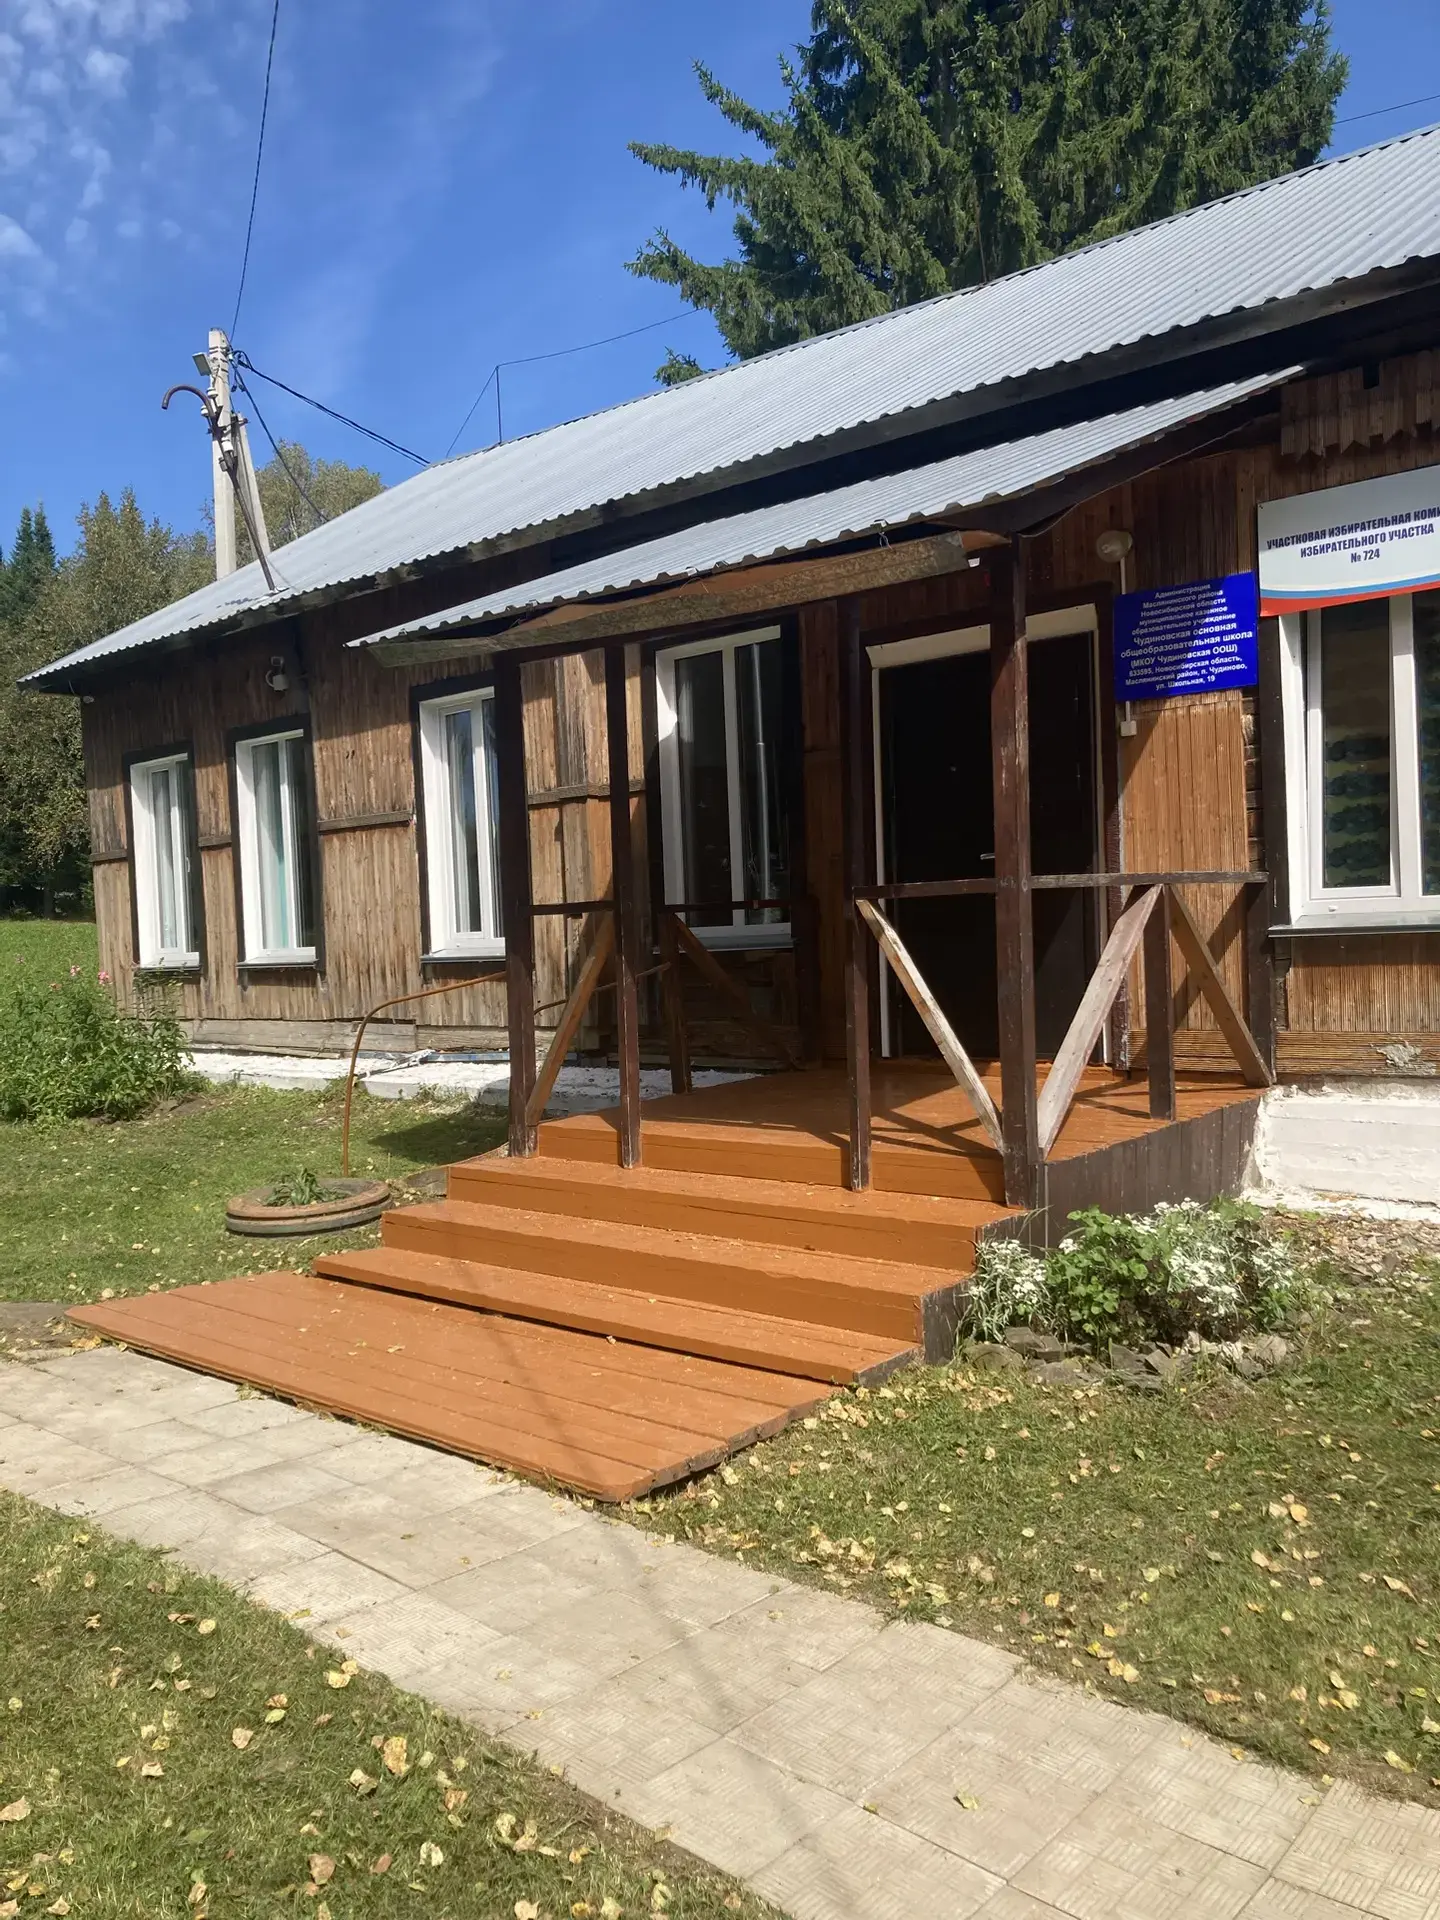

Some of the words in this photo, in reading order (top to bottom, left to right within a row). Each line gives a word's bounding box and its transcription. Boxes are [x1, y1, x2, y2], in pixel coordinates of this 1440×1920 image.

[1267, 530, 1326, 549] УЧАСТКОВАЯ
[1329, 512, 1411, 538] ИЗБИРАТЕЛЬНАЯ
[1301, 533, 1386, 558] ИЗБИРАТЕЛЬНОГО
[1389, 524, 1434, 542] УЧАСТКА
[1351, 553, 1361, 563] №
[1363, 549, 1380, 560] 724
[1143, 595, 1196, 608] Маслянинского
[1198, 590, 1223, 600] района
[1155, 584, 1211, 599] Администрация
[1141, 603, 1195, 617] Новосибирской
[1197, 598, 1226, 607] области
[1132, 621, 1191, 635] образовательное
[1193, 613, 1236, 626] учреждение
[1140, 612, 1194, 626] муниципальное
[1121, 636, 1220, 658] общеобразовательная
[1223, 631, 1252, 641] школа
[1133, 630, 1190, 646] Чудиновская
[1193, 623, 1237, 635] основная
[1130, 656, 1155, 669] (МКОУ
[1157, 650, 1211, 664] Чудиновская
[1212, 644, 1238, 654] ООШ)
[1155, 660, 1209, 673] Новосибирская
[1211, 656, 1242, 665] область,
[1126, 674, 1175, 685] Маслянинский
[1177, 670, 1199, 679] район,
[1209, 664, 1247, 674] Чудиново,
[1168, 677, 1205, 688] Школьная,
